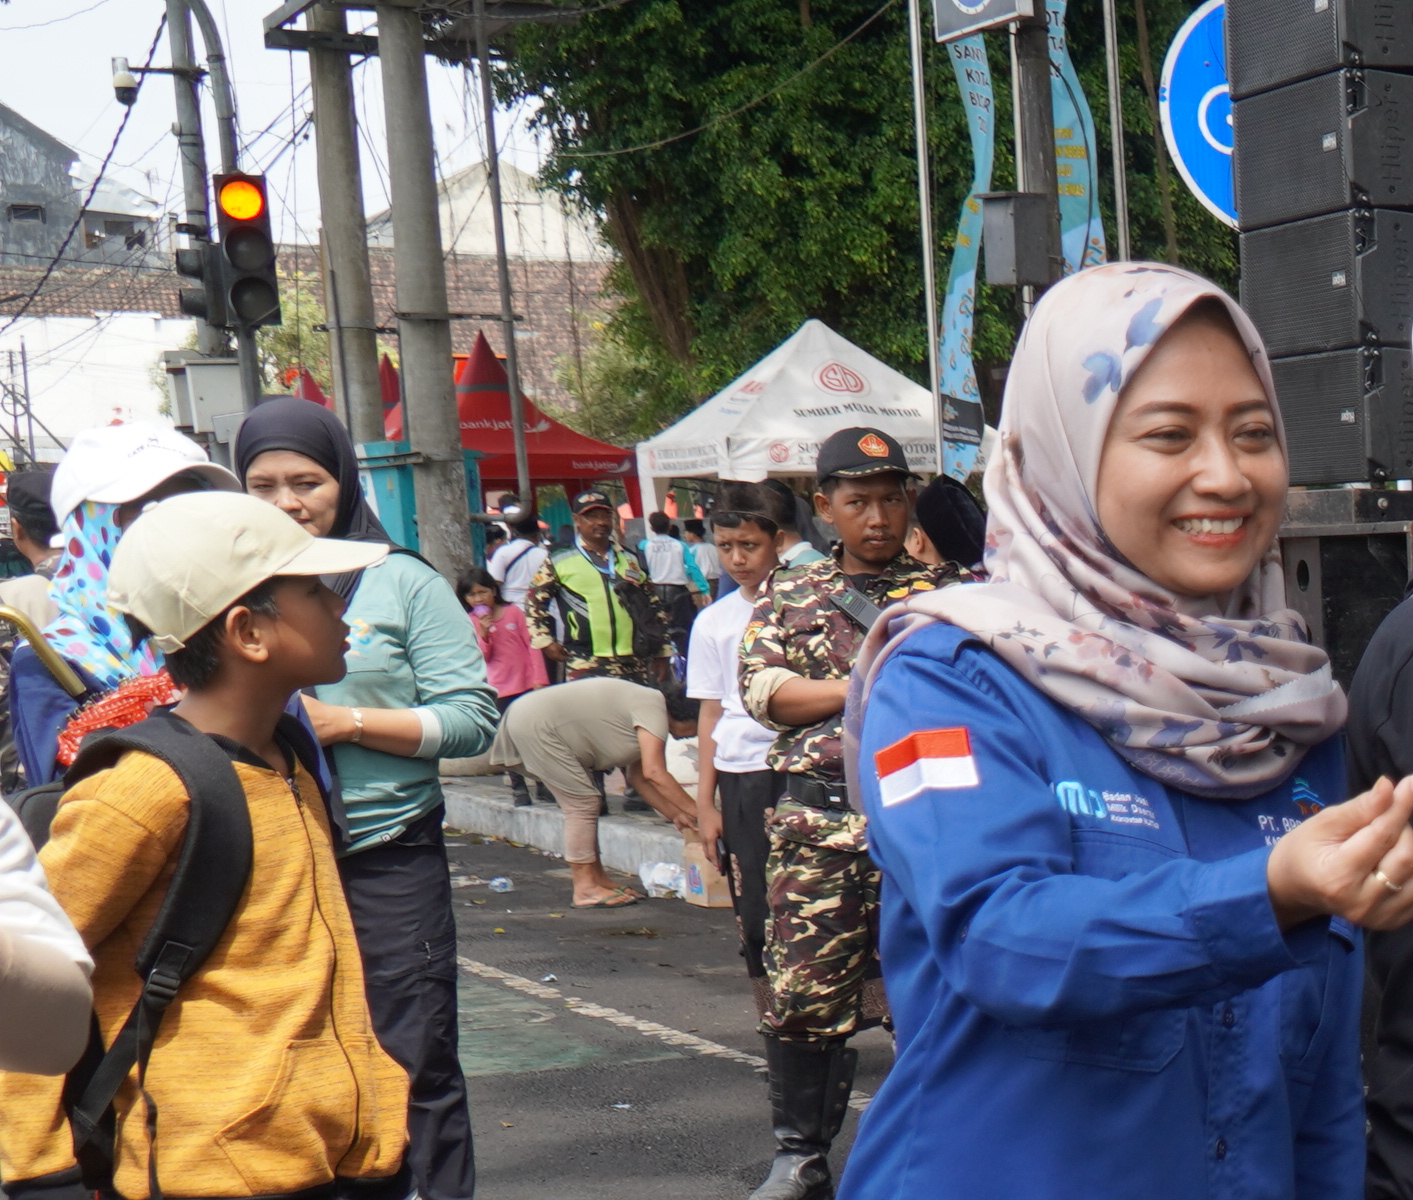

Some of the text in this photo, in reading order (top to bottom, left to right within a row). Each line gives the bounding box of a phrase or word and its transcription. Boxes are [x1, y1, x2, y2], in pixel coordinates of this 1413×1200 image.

[793, 403, 922, 418] SUMBER MULIA MOTOR
[901, 443, 936, 454] OTOR
[1102, 791, 1131, 801] Badan
[1258, 815, 1279, 832] PT.
